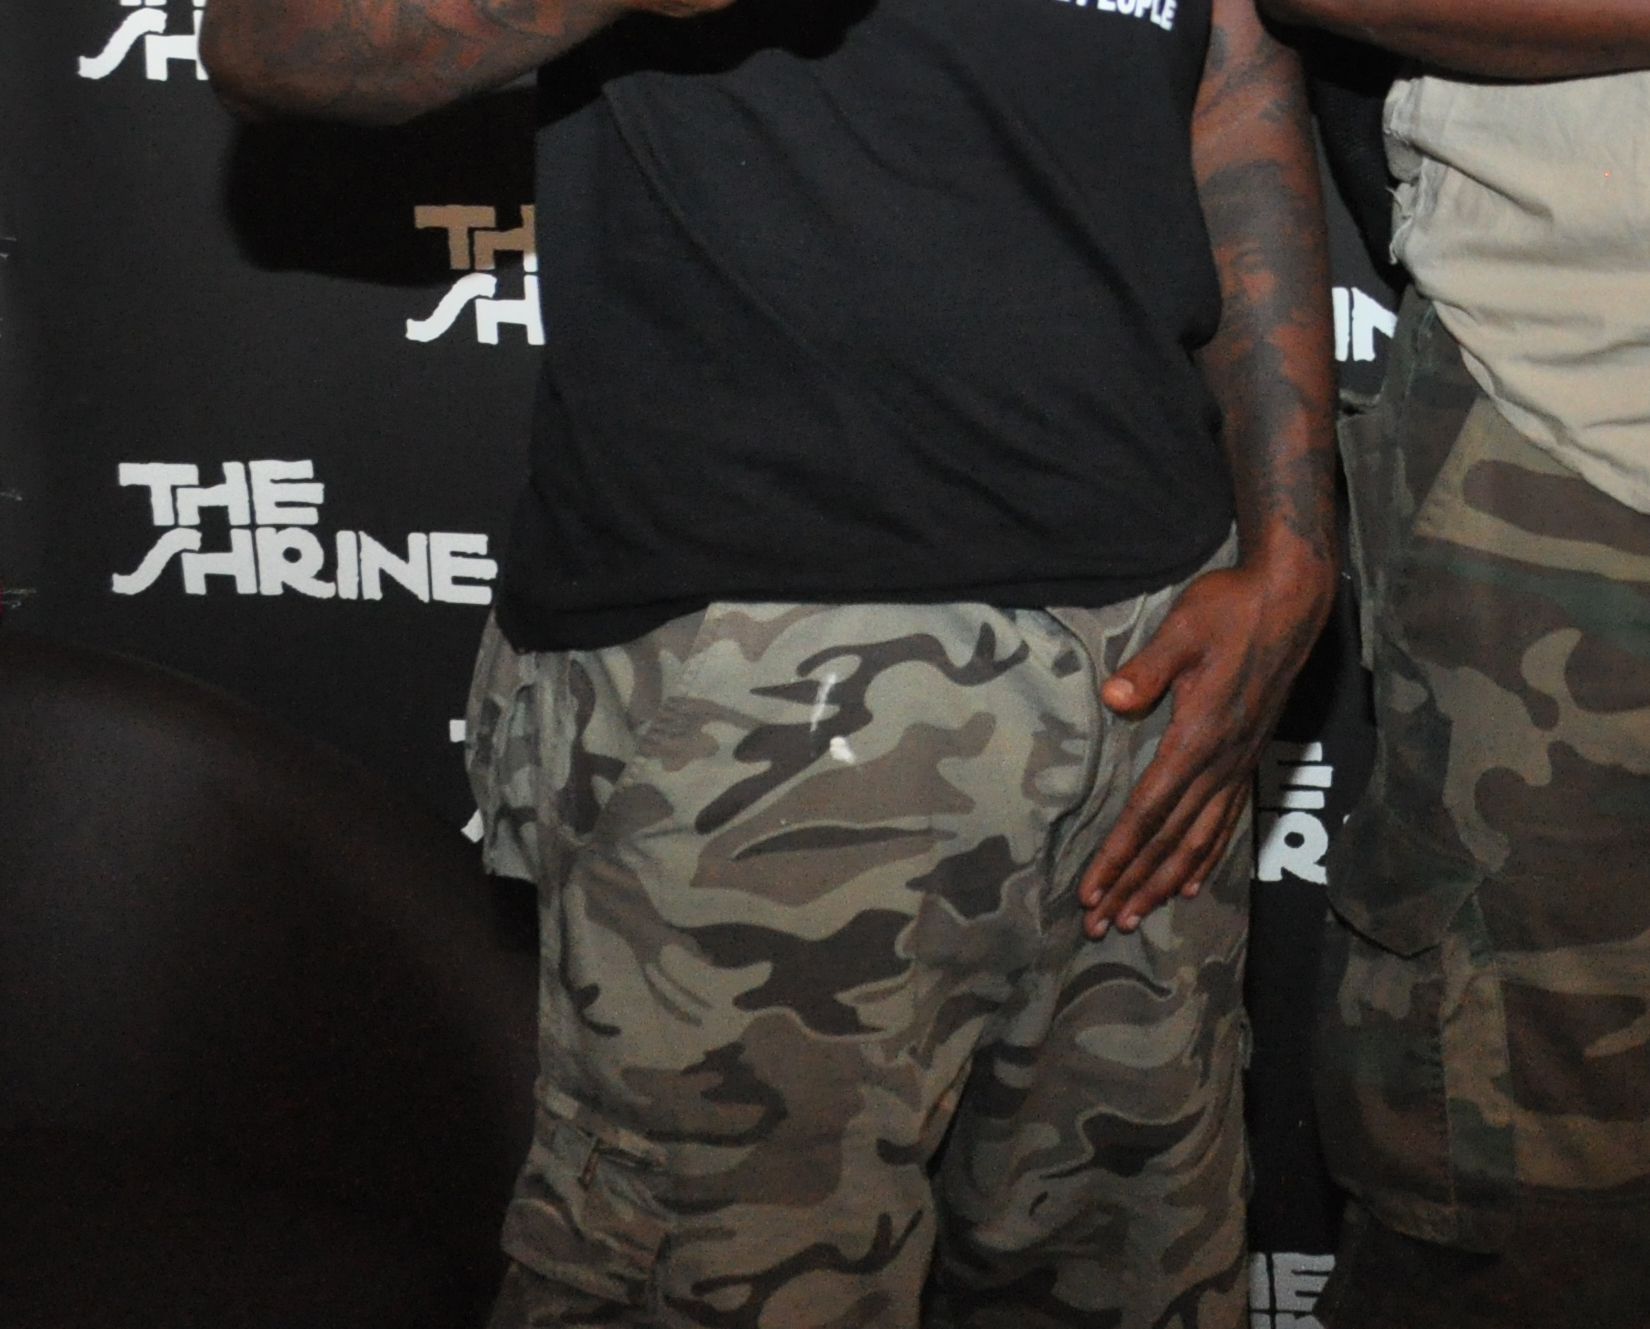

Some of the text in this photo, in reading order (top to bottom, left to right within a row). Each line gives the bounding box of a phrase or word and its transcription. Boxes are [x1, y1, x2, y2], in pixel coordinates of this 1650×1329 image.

[414, 205, 536, 271] TH
[118, 459, 325, 526] THE
[112, 527, 498, 605] SHRINE
